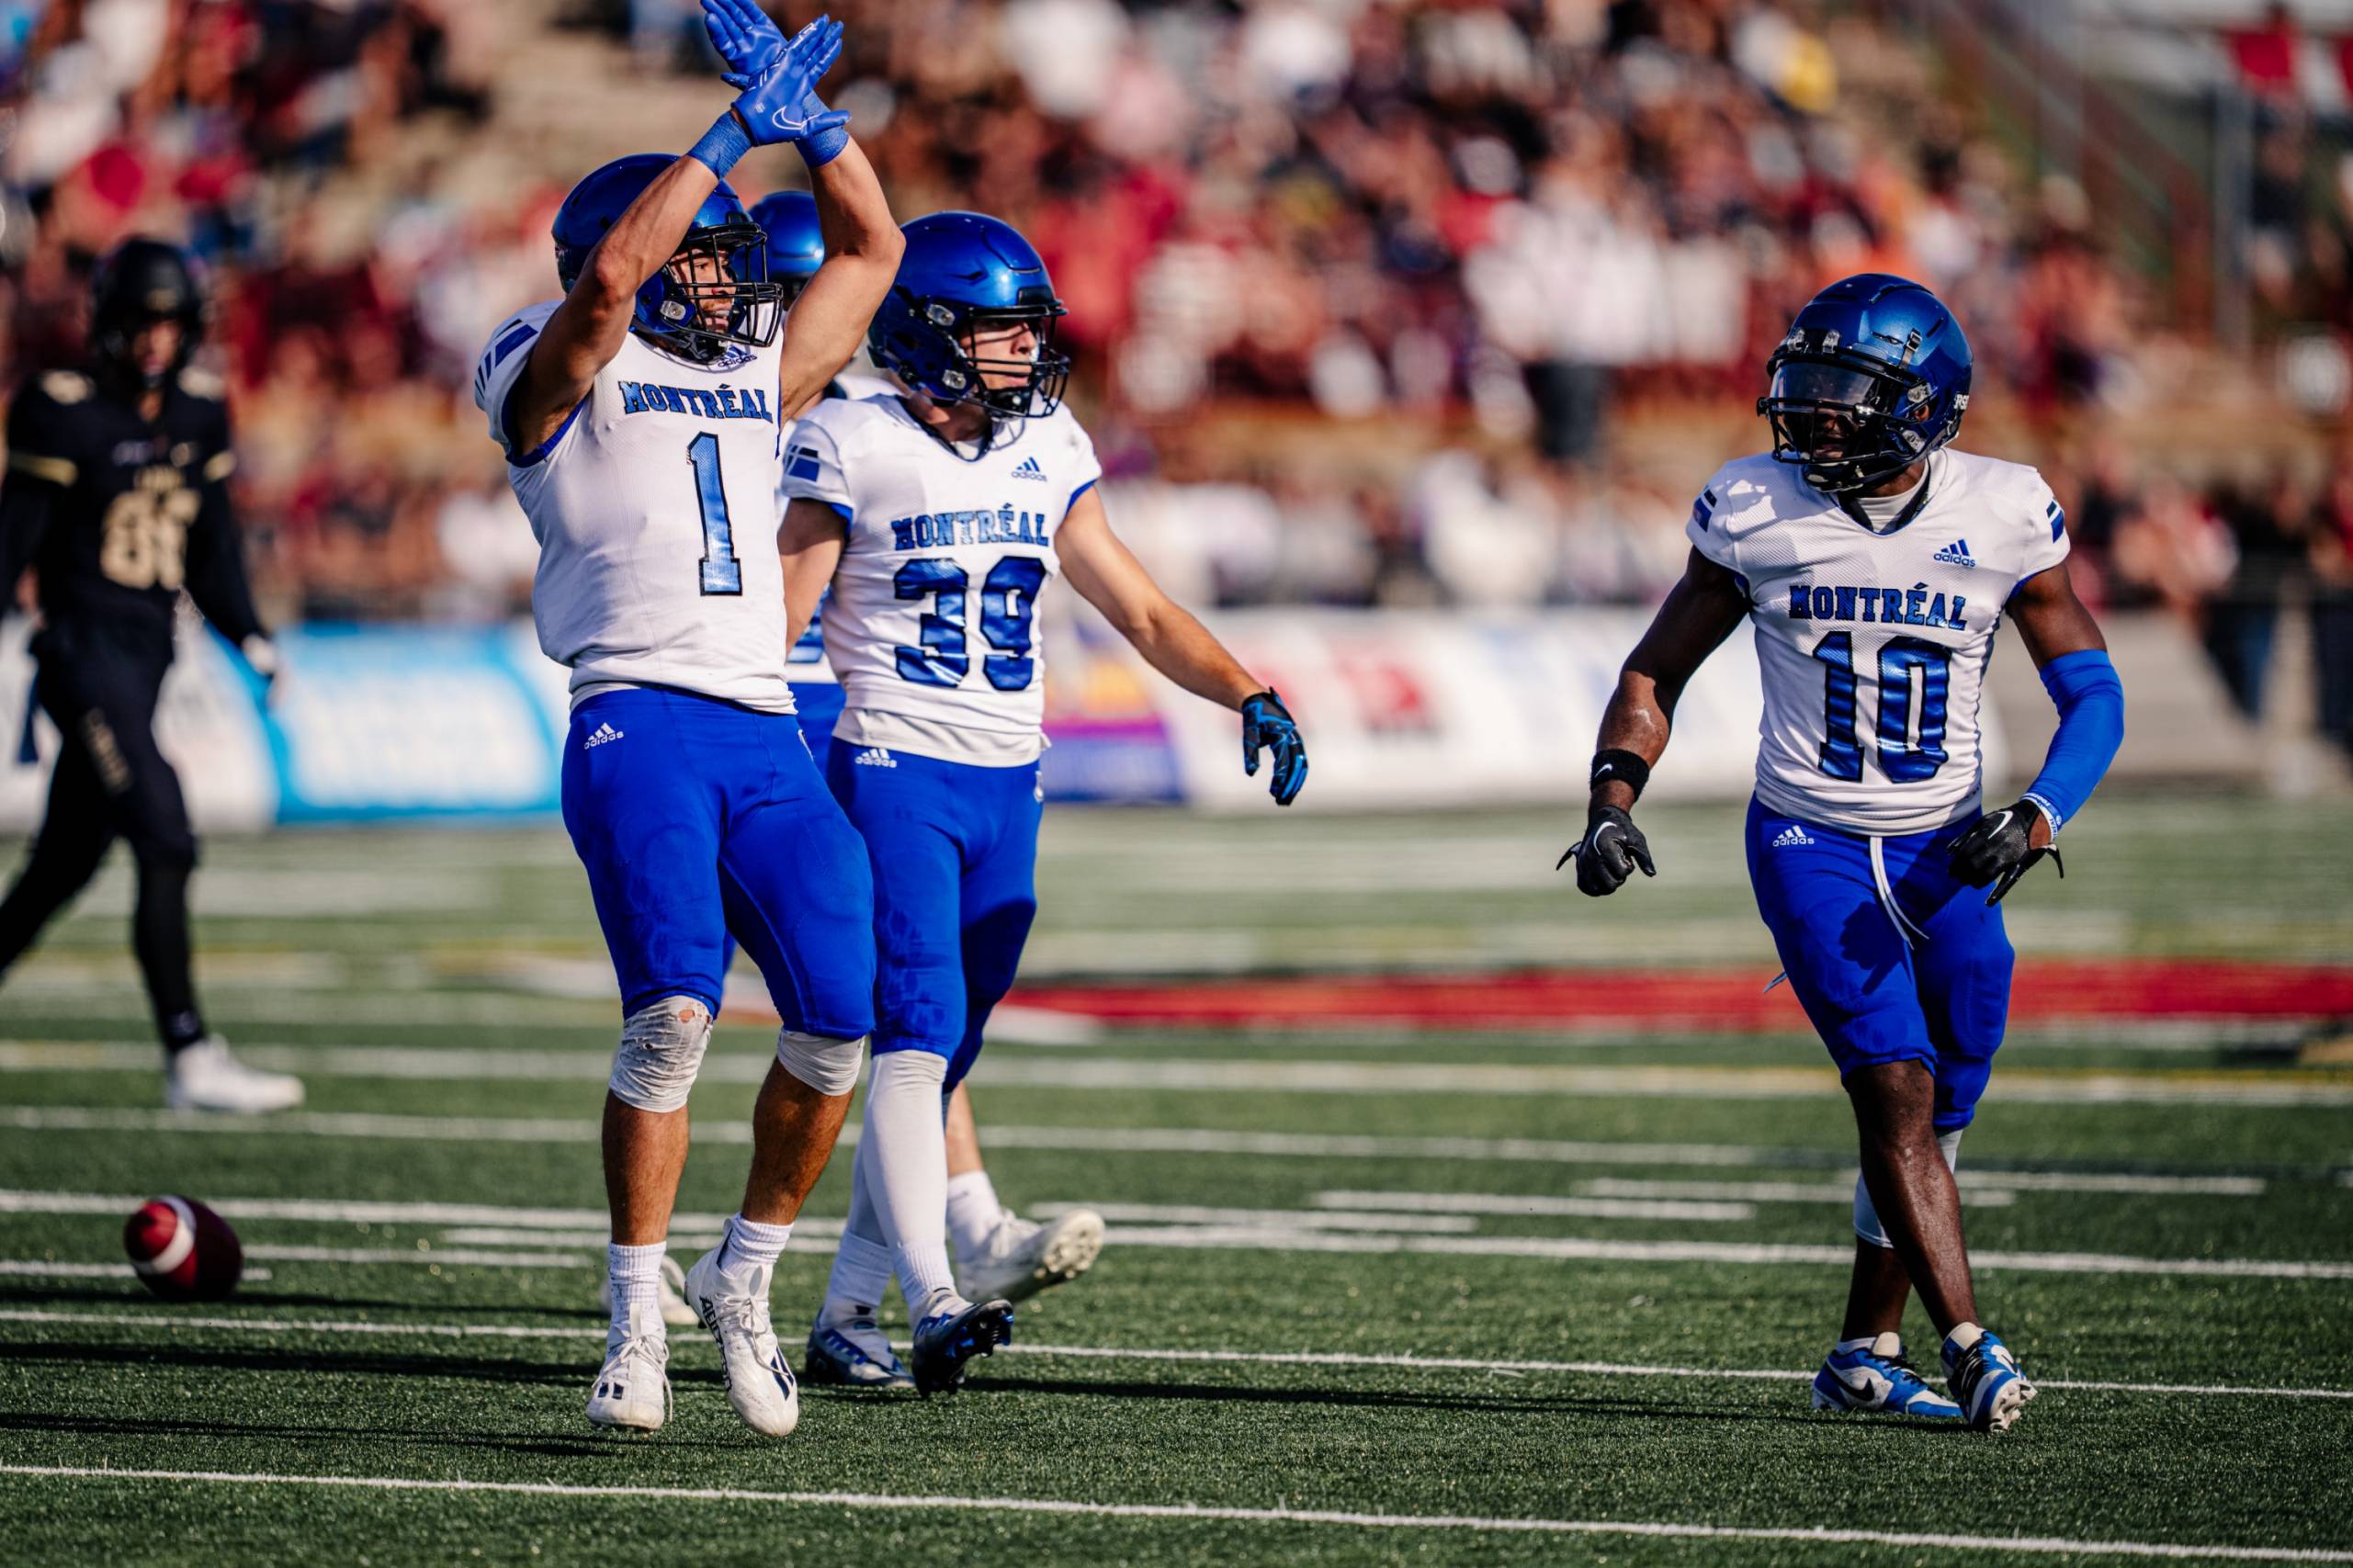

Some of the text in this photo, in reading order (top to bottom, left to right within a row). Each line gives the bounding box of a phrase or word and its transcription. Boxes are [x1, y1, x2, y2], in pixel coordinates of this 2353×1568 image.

[718, 354, 758, 367] adidas
[617, 380, 774, 423] MONTRÉAL
[1011, 470, 1047, 482] adidas
[686, 431, 743, 596] 1
[890, 502, 1049, 551] MONTRÉAL
[1933, 552, 1976, 568] adidas
[1789, 581, 1968, 631] MONTRÉAL
[893, 555, 1047, 692] 39
[1812, 630, 1953, 784] 10
[583, 730, 624, 750] adidas
[854, 755, 897, 768] adidas
[1772, 836, 1815, 847] adidas
